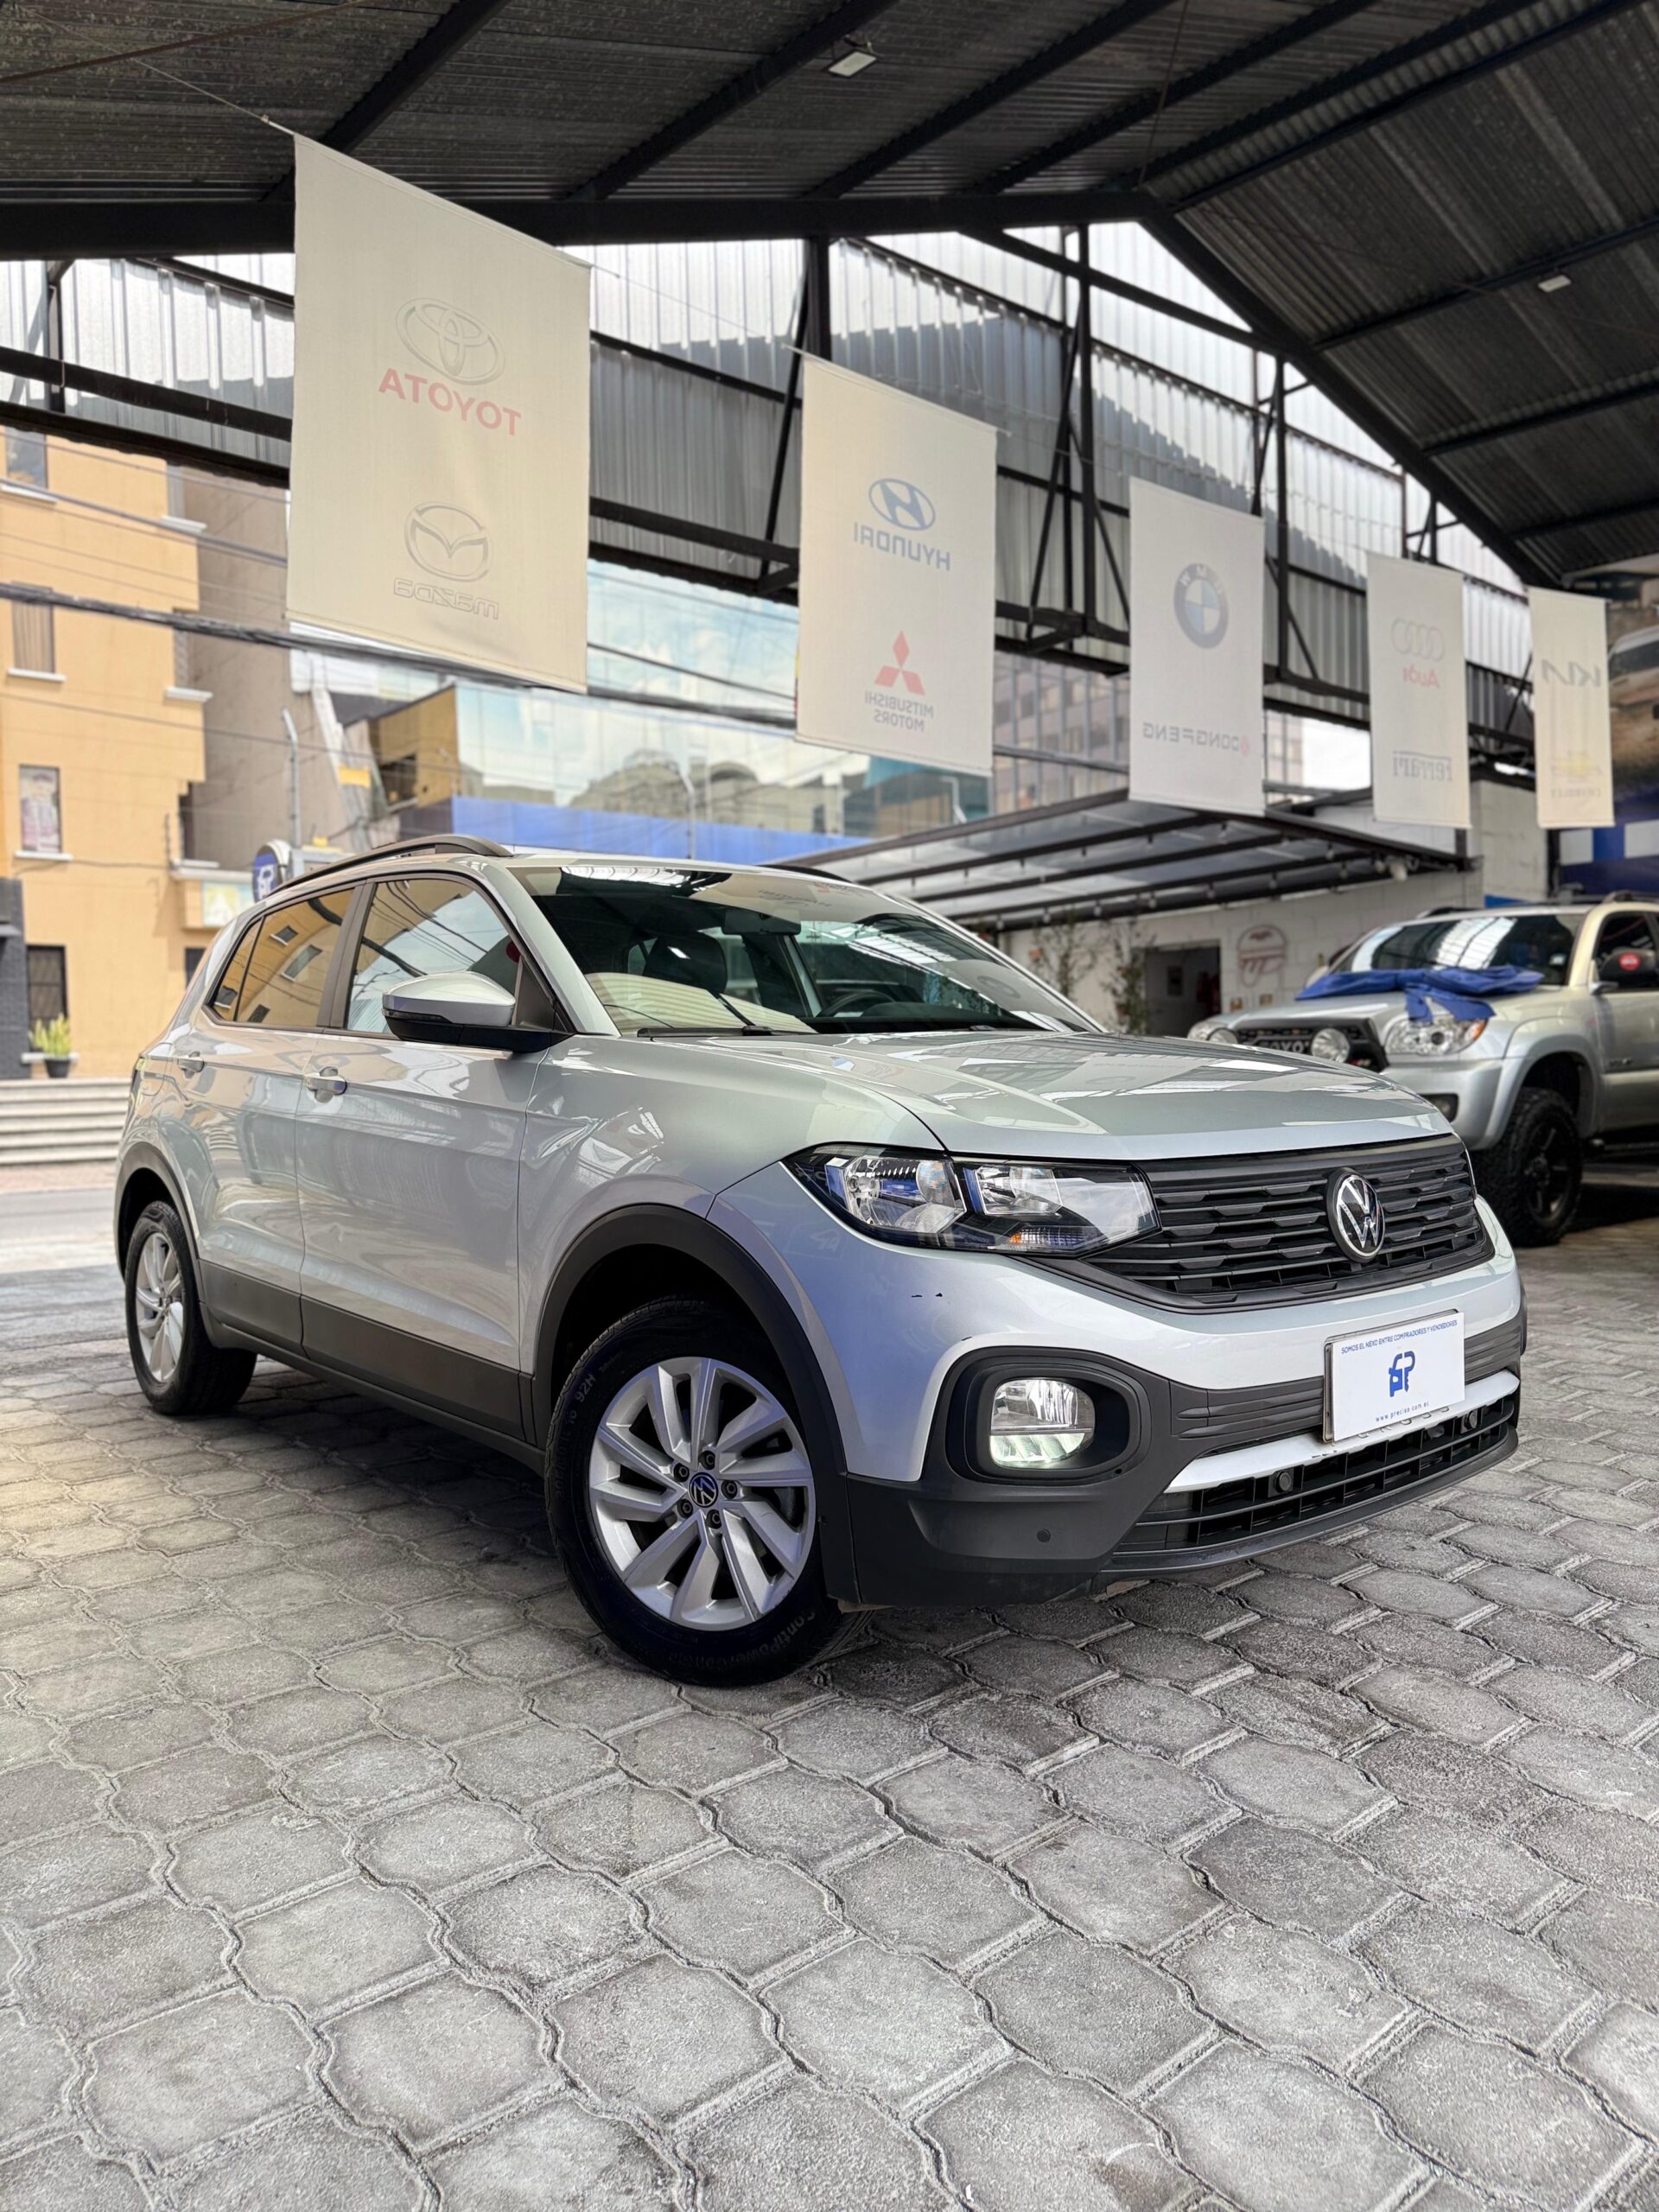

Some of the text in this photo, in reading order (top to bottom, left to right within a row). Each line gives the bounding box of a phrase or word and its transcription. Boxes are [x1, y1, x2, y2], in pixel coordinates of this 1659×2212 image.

[1341, 1344, 1359, 1354] SOMOS
[1378, 1336, 1394, 1344] ENTRE
[1394, 1329, 1427, 1341] COMPRADORES
[575, 1373, 597, 1403] 92H
